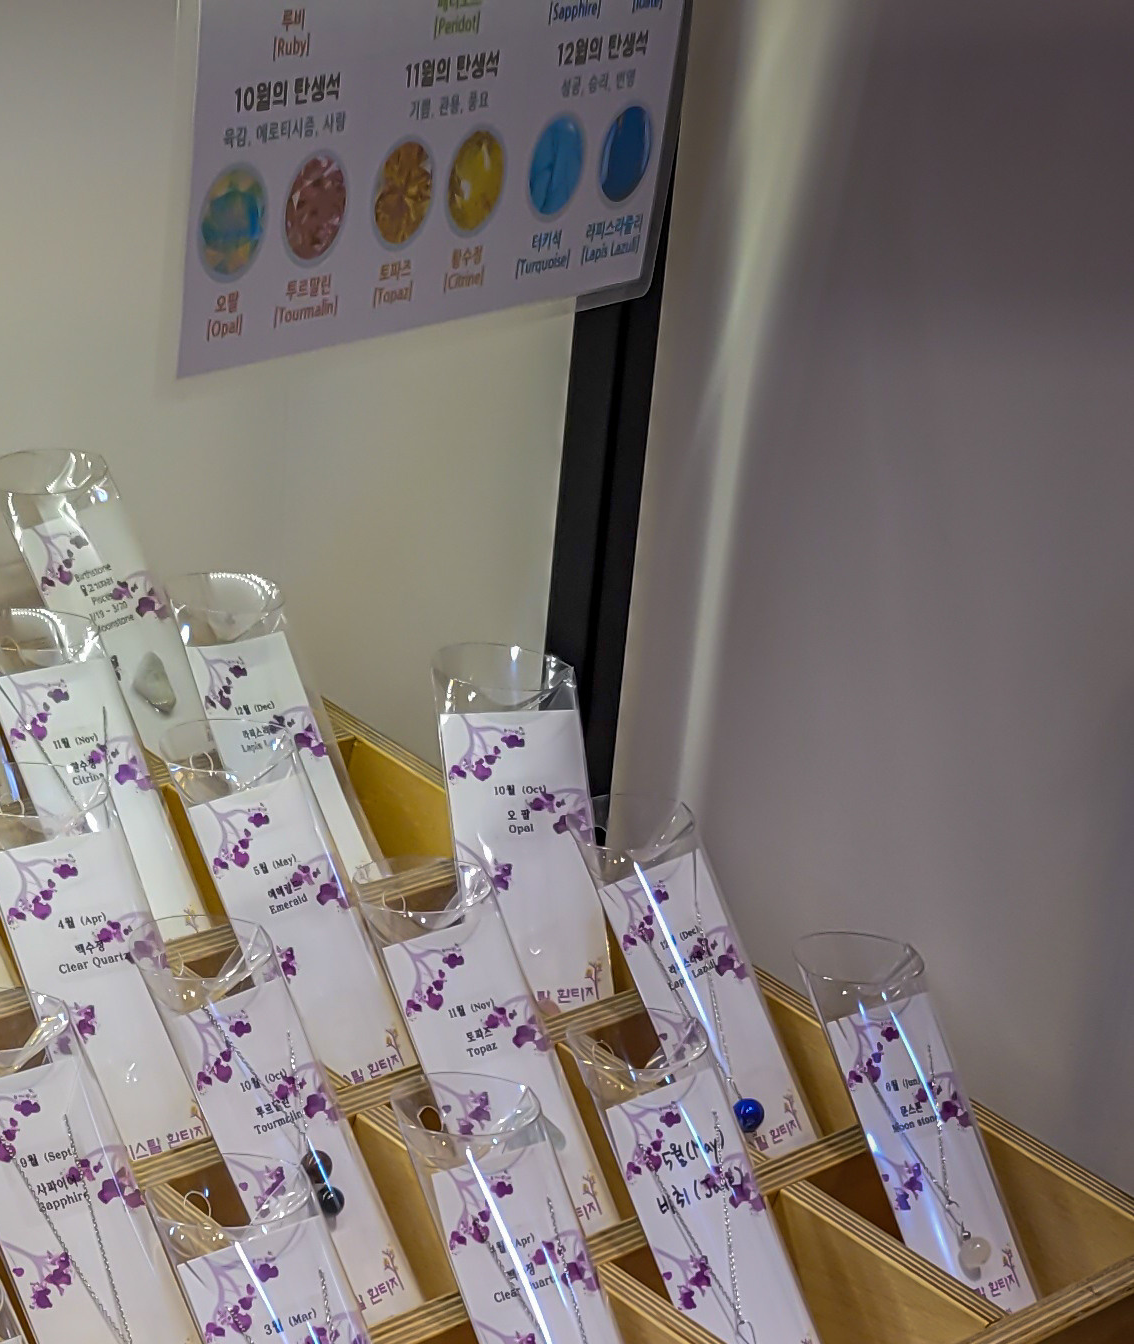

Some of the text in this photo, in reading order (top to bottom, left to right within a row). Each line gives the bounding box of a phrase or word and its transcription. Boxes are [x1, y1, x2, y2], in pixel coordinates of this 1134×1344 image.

[282, 9, 306, 30] 루비
[558, 29, 649, 66] 12월의 탄생석
[405, 50, 500, 88] 11월의 탄생석
[235, 72, 341, 112] 10월의 탄생석
[322, 111, 346, 133] 사랑
[531, 229, 563, 251] 터키석
[379, 259, 411, 281] 토파즈
[286, 274, 332, 300] 투르말린
[215, 291, 239, 314] 오팔
[75, 733, 100, 746] (Nov)
[493, 782, 547, 797] 10월 (Oct)
[508, 822, 535, 836] Opal
[253, 853, 297, 876] 5월 (May)
[269, 893, 308, 915] Emerald
[57, 912, 107, 929] 4월 (Apr)
[679, 925, 699, 941] (Dec)
[75, 940, 105, 955] 백수정
[58, 950, 130, 976] Clear Quartz
[448, 998, 495, 1019] 11월 (Nov)
[466, 1042, 498, 1058] Topaz
[265, 1068, 287, 1085] (Oct)
[288, 1306, 317, 1328] (Mar)
